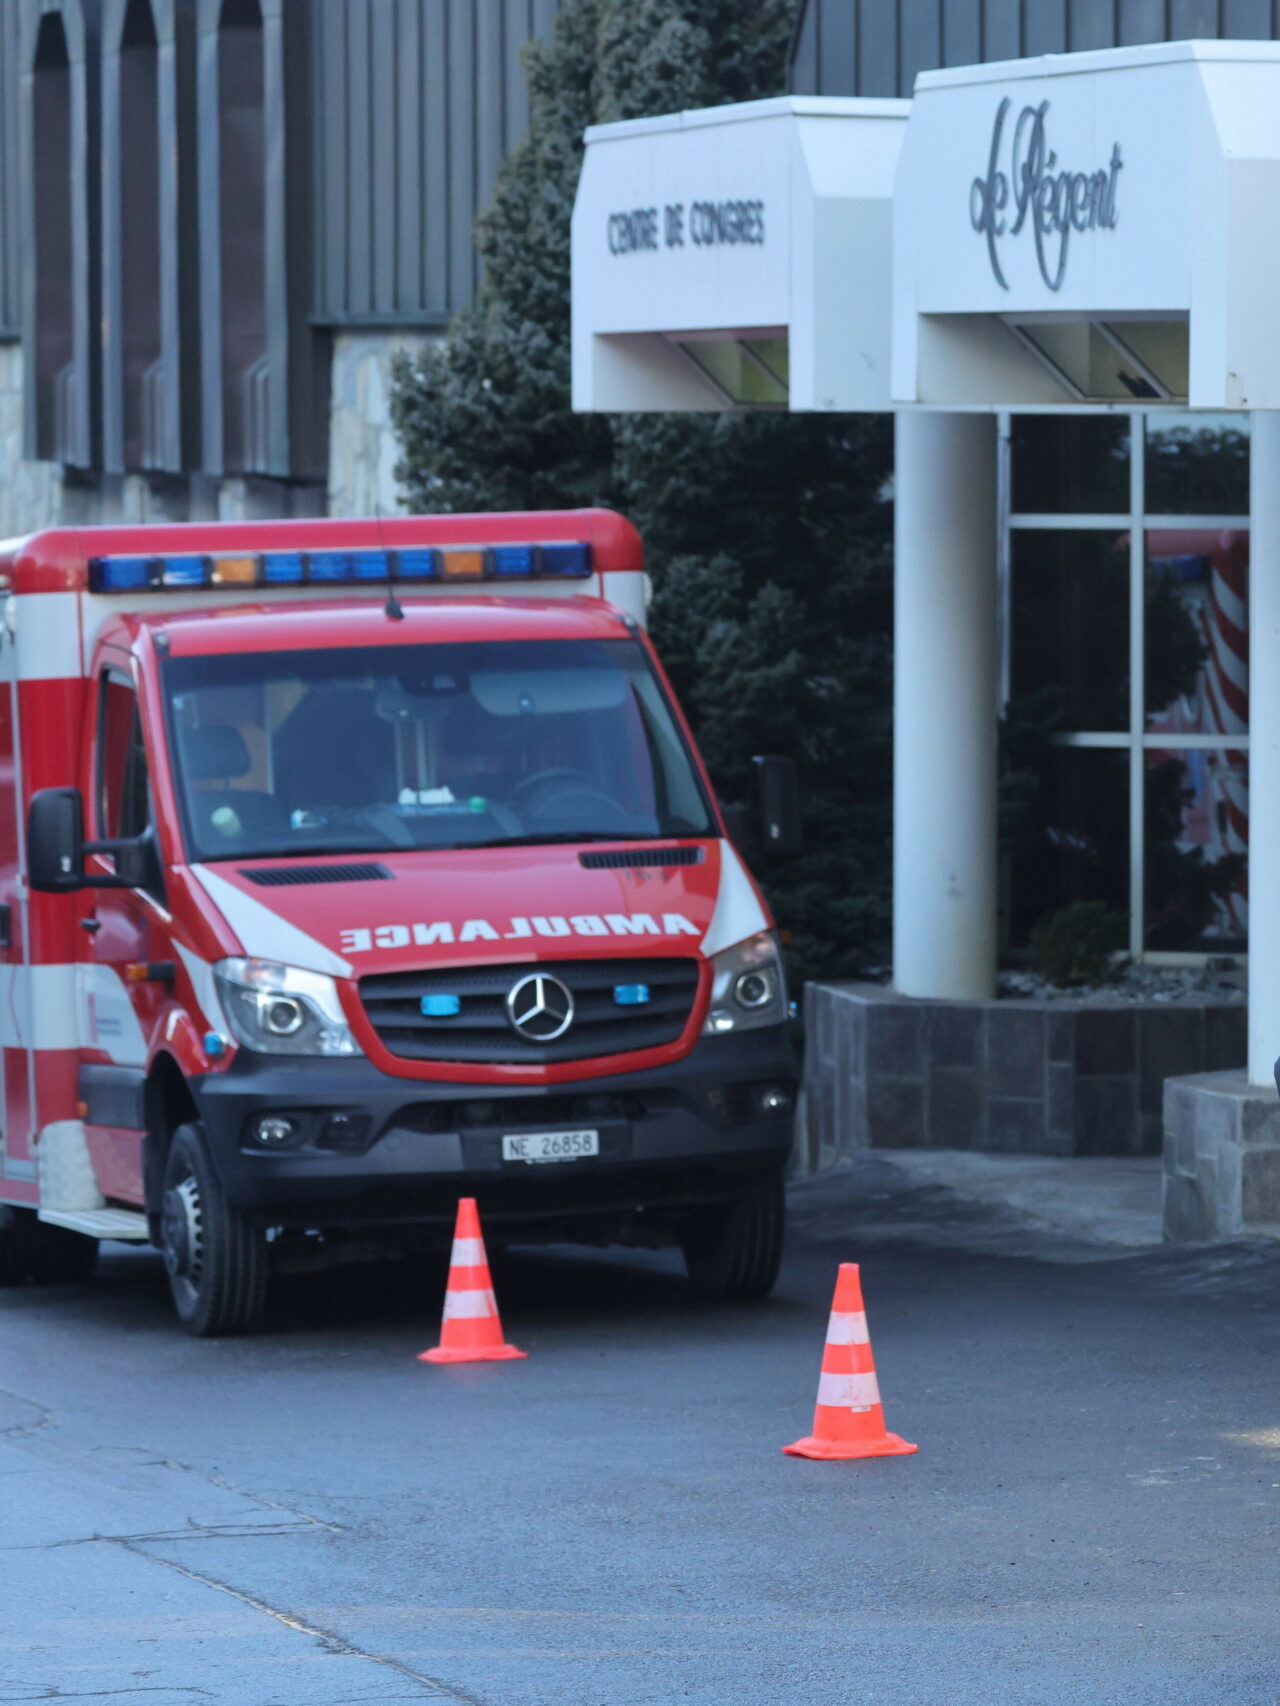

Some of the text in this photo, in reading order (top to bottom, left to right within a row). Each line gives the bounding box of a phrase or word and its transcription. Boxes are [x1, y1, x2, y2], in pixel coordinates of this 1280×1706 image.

[607, 207, 658, 256] CENTRE
[664, 202, 684, 247] DE
[509, 1134, 593, 1156] NE 26858
